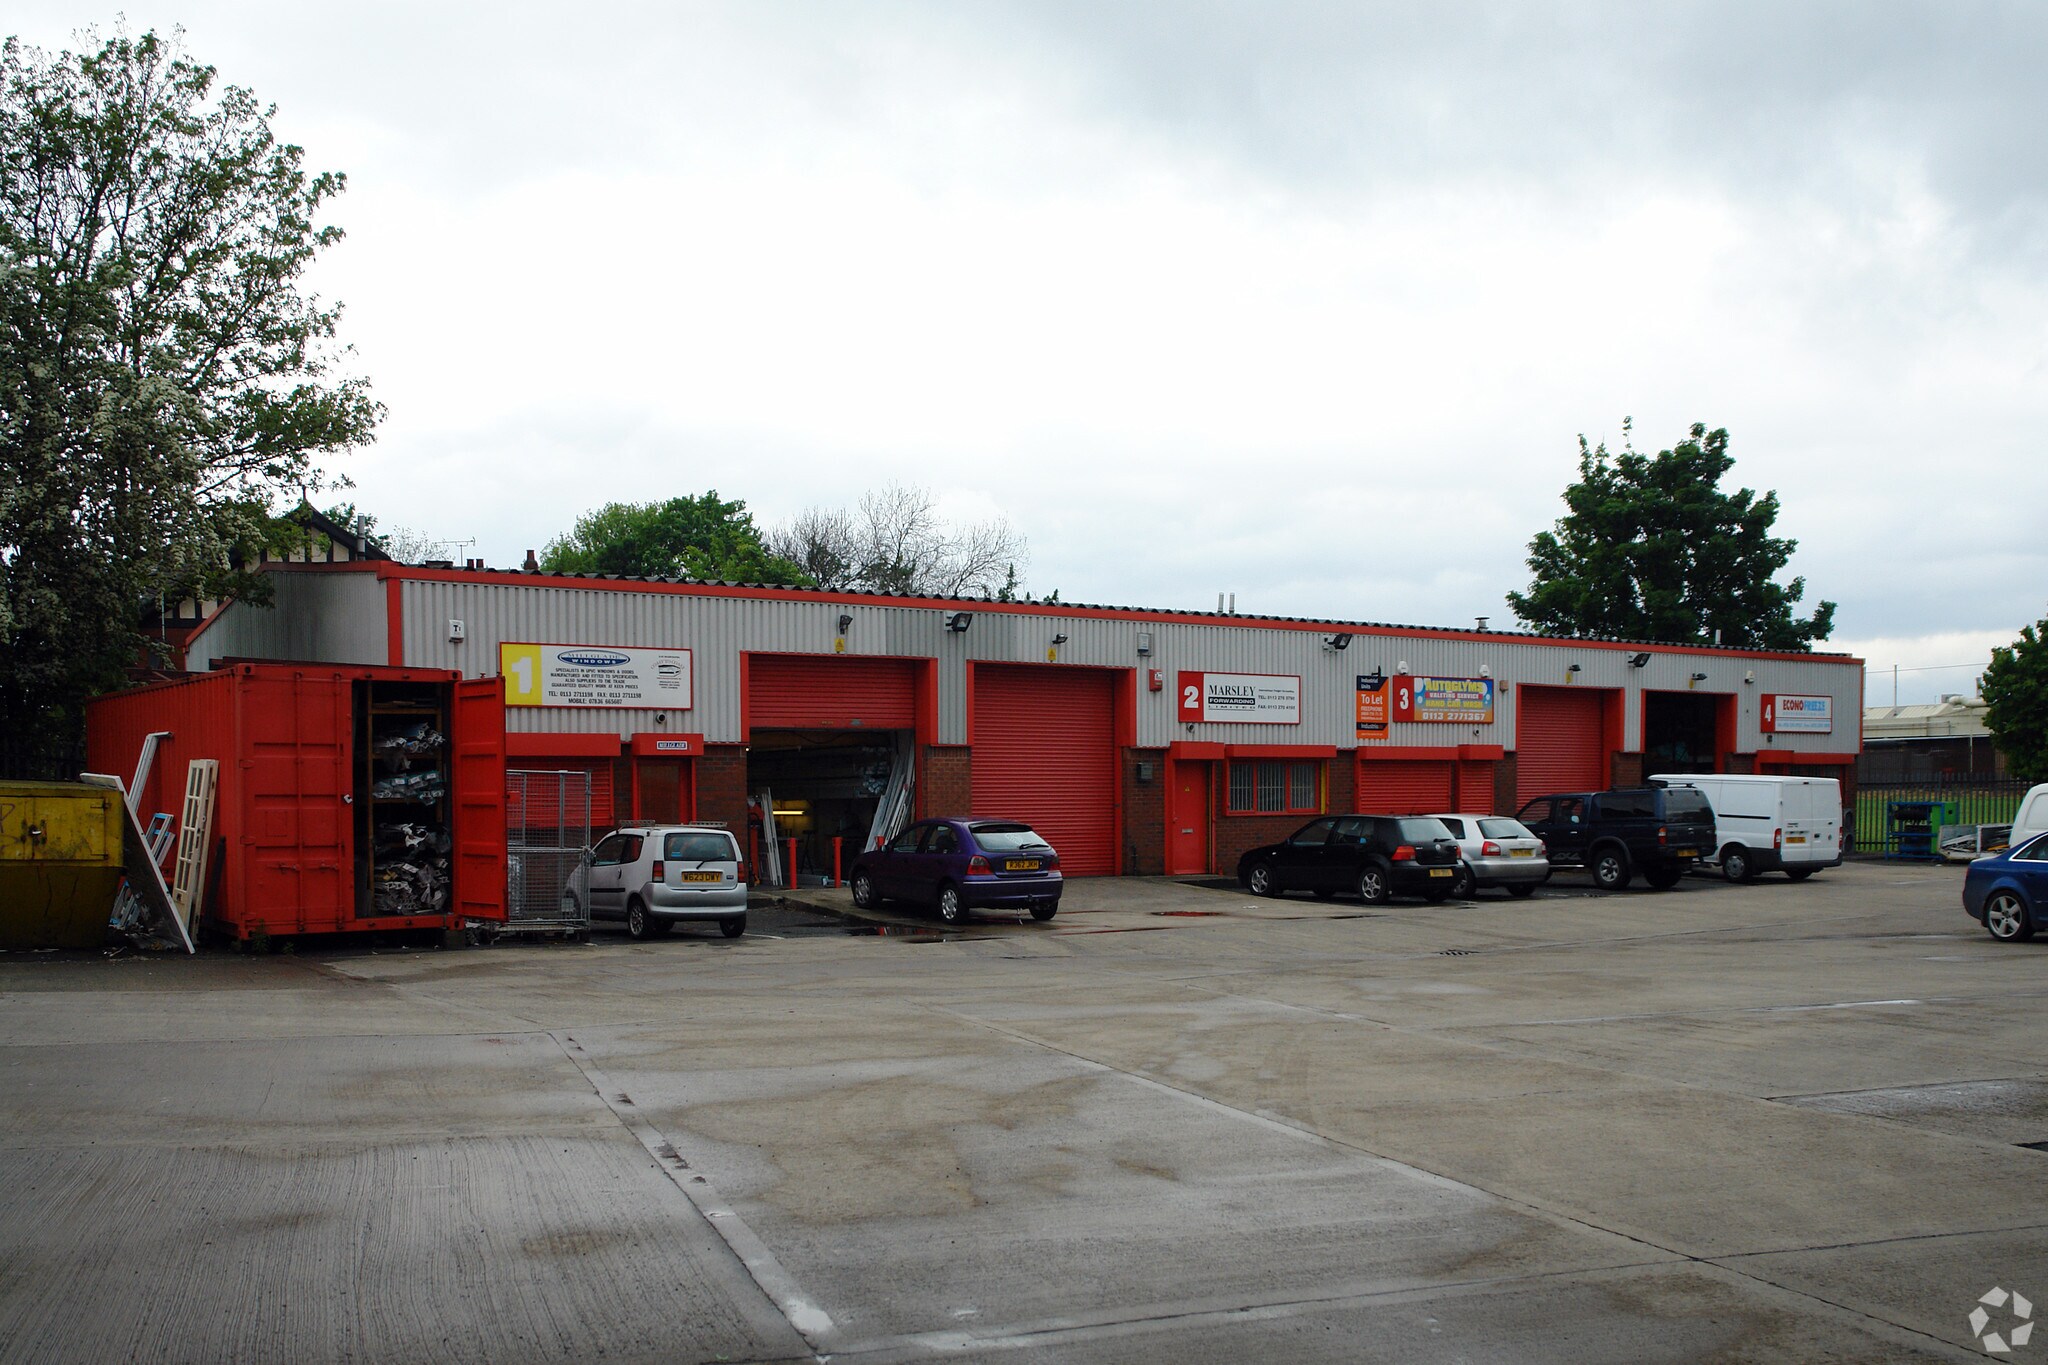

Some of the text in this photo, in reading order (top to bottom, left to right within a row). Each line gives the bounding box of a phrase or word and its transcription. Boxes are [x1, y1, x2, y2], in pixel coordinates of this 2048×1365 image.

[512, 656, 532, 694] 1
[1184, 685, 1199, 709] 2
[1208, 684, 1256, 697] MARSLEY
[1361, 693, 1383, 705] To Let
[1399, 687, 1409, 710] 3
[1422, 712, 1444, 720] 0113
[1765, 704, 1772, 722] 4
